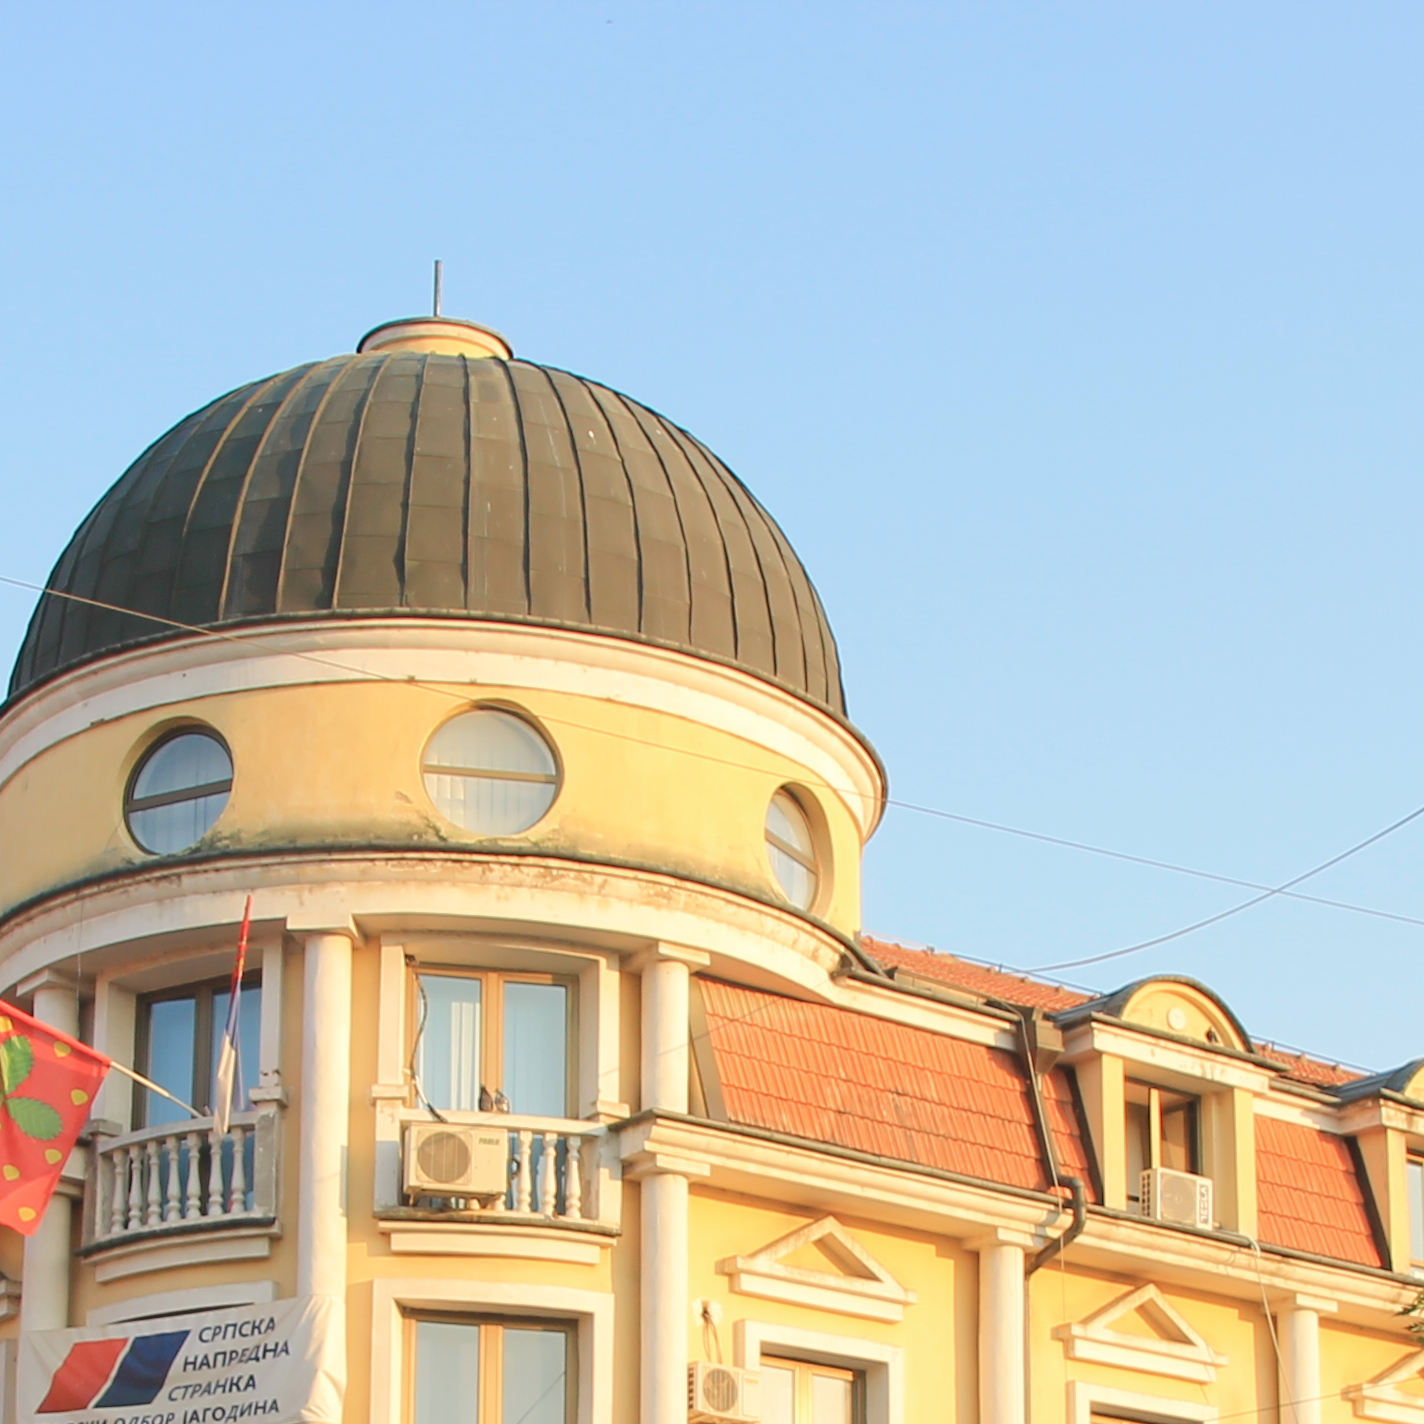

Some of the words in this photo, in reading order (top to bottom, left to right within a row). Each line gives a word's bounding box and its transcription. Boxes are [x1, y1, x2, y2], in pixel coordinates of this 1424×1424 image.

[198, 1316, 276, 1344] СРПСКА
[182, 1340, 291, 1373] НАПРЕДНА
[168, 1374, 256, 1402] СТРАНКА
